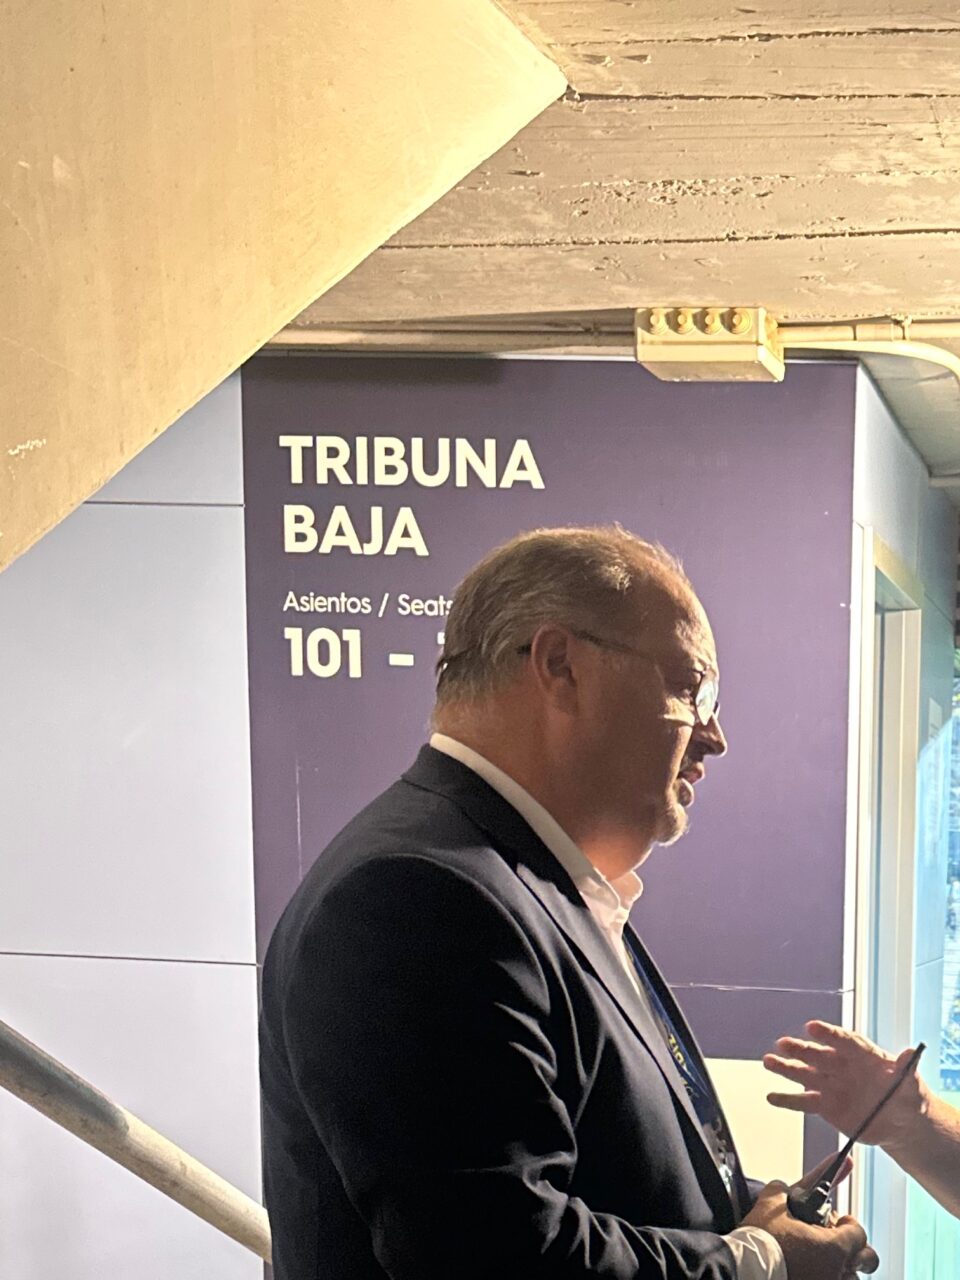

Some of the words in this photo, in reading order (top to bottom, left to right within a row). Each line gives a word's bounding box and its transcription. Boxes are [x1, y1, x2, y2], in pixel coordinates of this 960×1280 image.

[278, 434, 546, 490] TRIBUNA
[283, 504, 430, 557] BAJA
[282, 590, 372, 615] Asientos
[397, 593, 454, 617] Seats
[283, 626, 363, 679] 101
